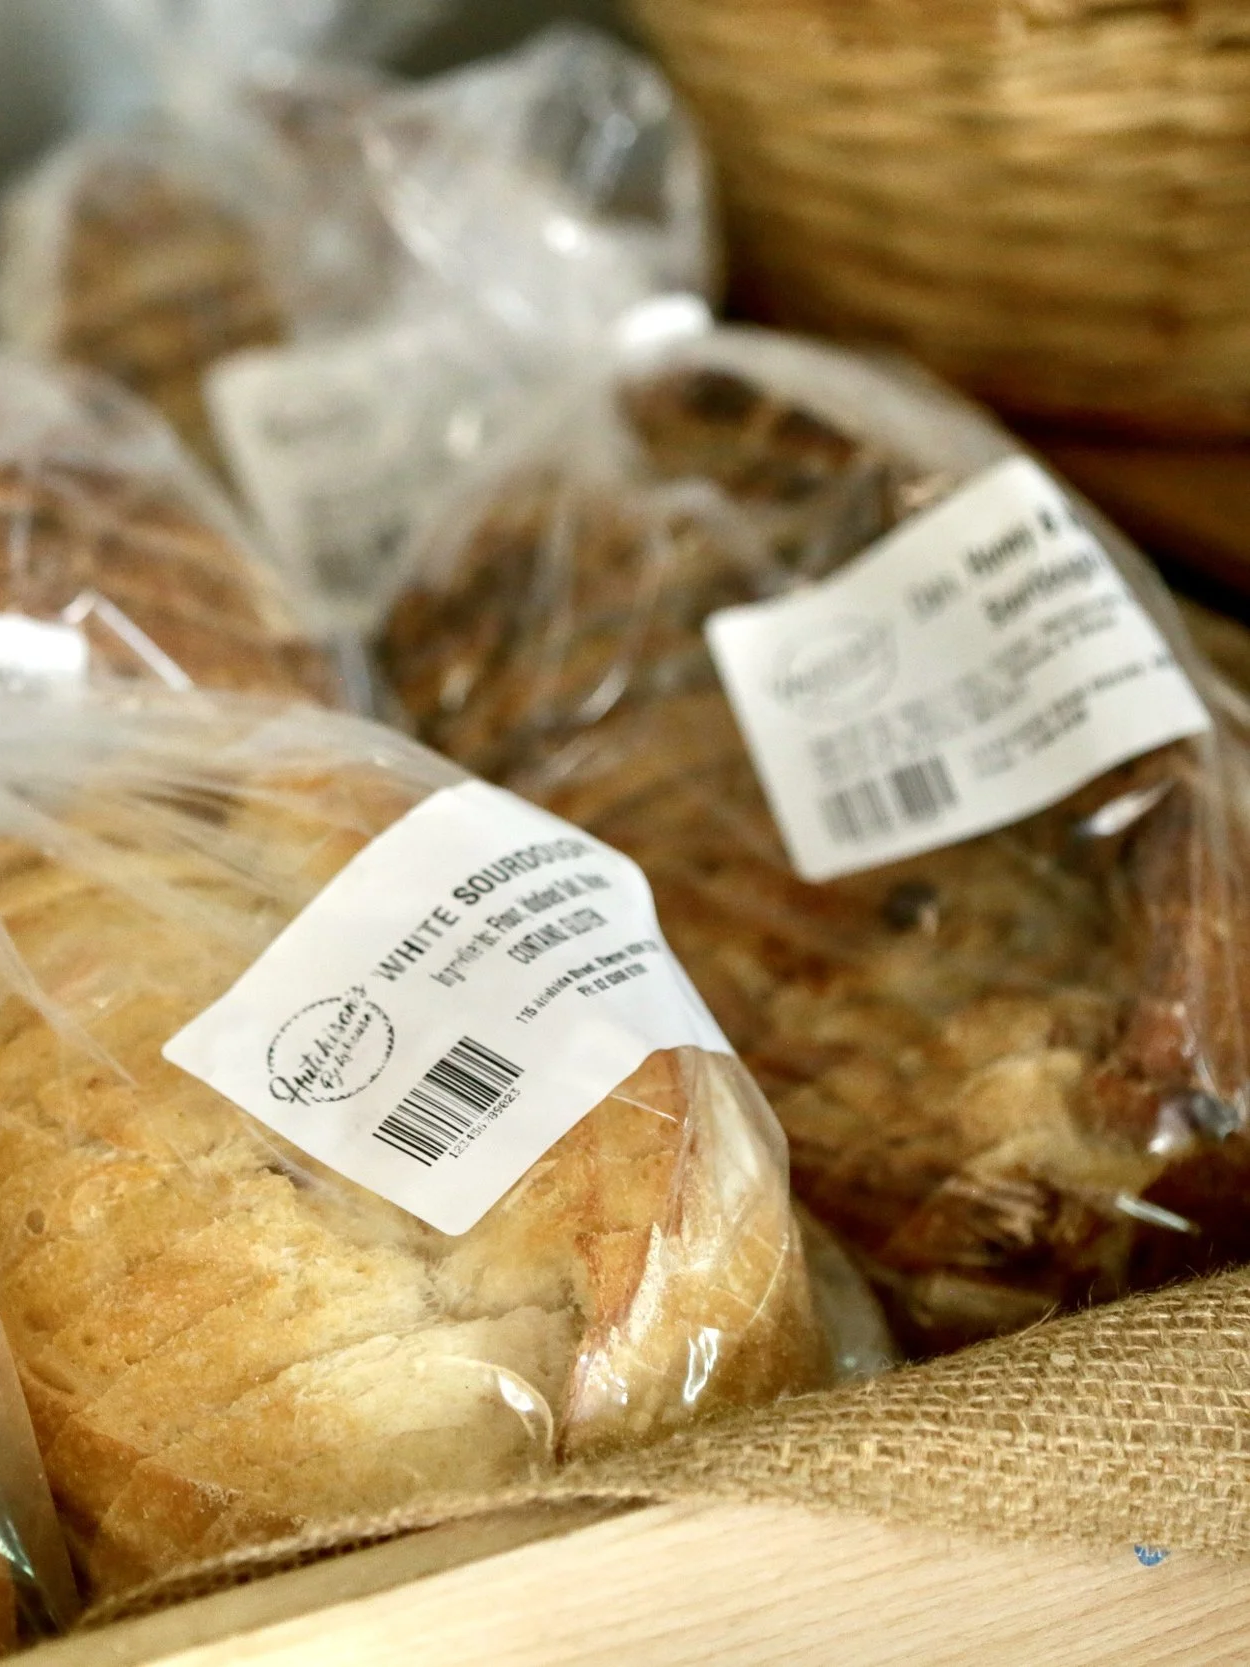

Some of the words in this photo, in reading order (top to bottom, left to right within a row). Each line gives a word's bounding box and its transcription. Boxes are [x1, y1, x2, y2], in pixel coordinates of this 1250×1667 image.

[373, 905, 460, 981] WHITE
[453, 839, 594, 906] SOURDOUGH
[506, 924, 569, 964] CONTAINS
[269, 985, 366, 1106] Hutchison's
[515, 1006, 537, 1024] 115
